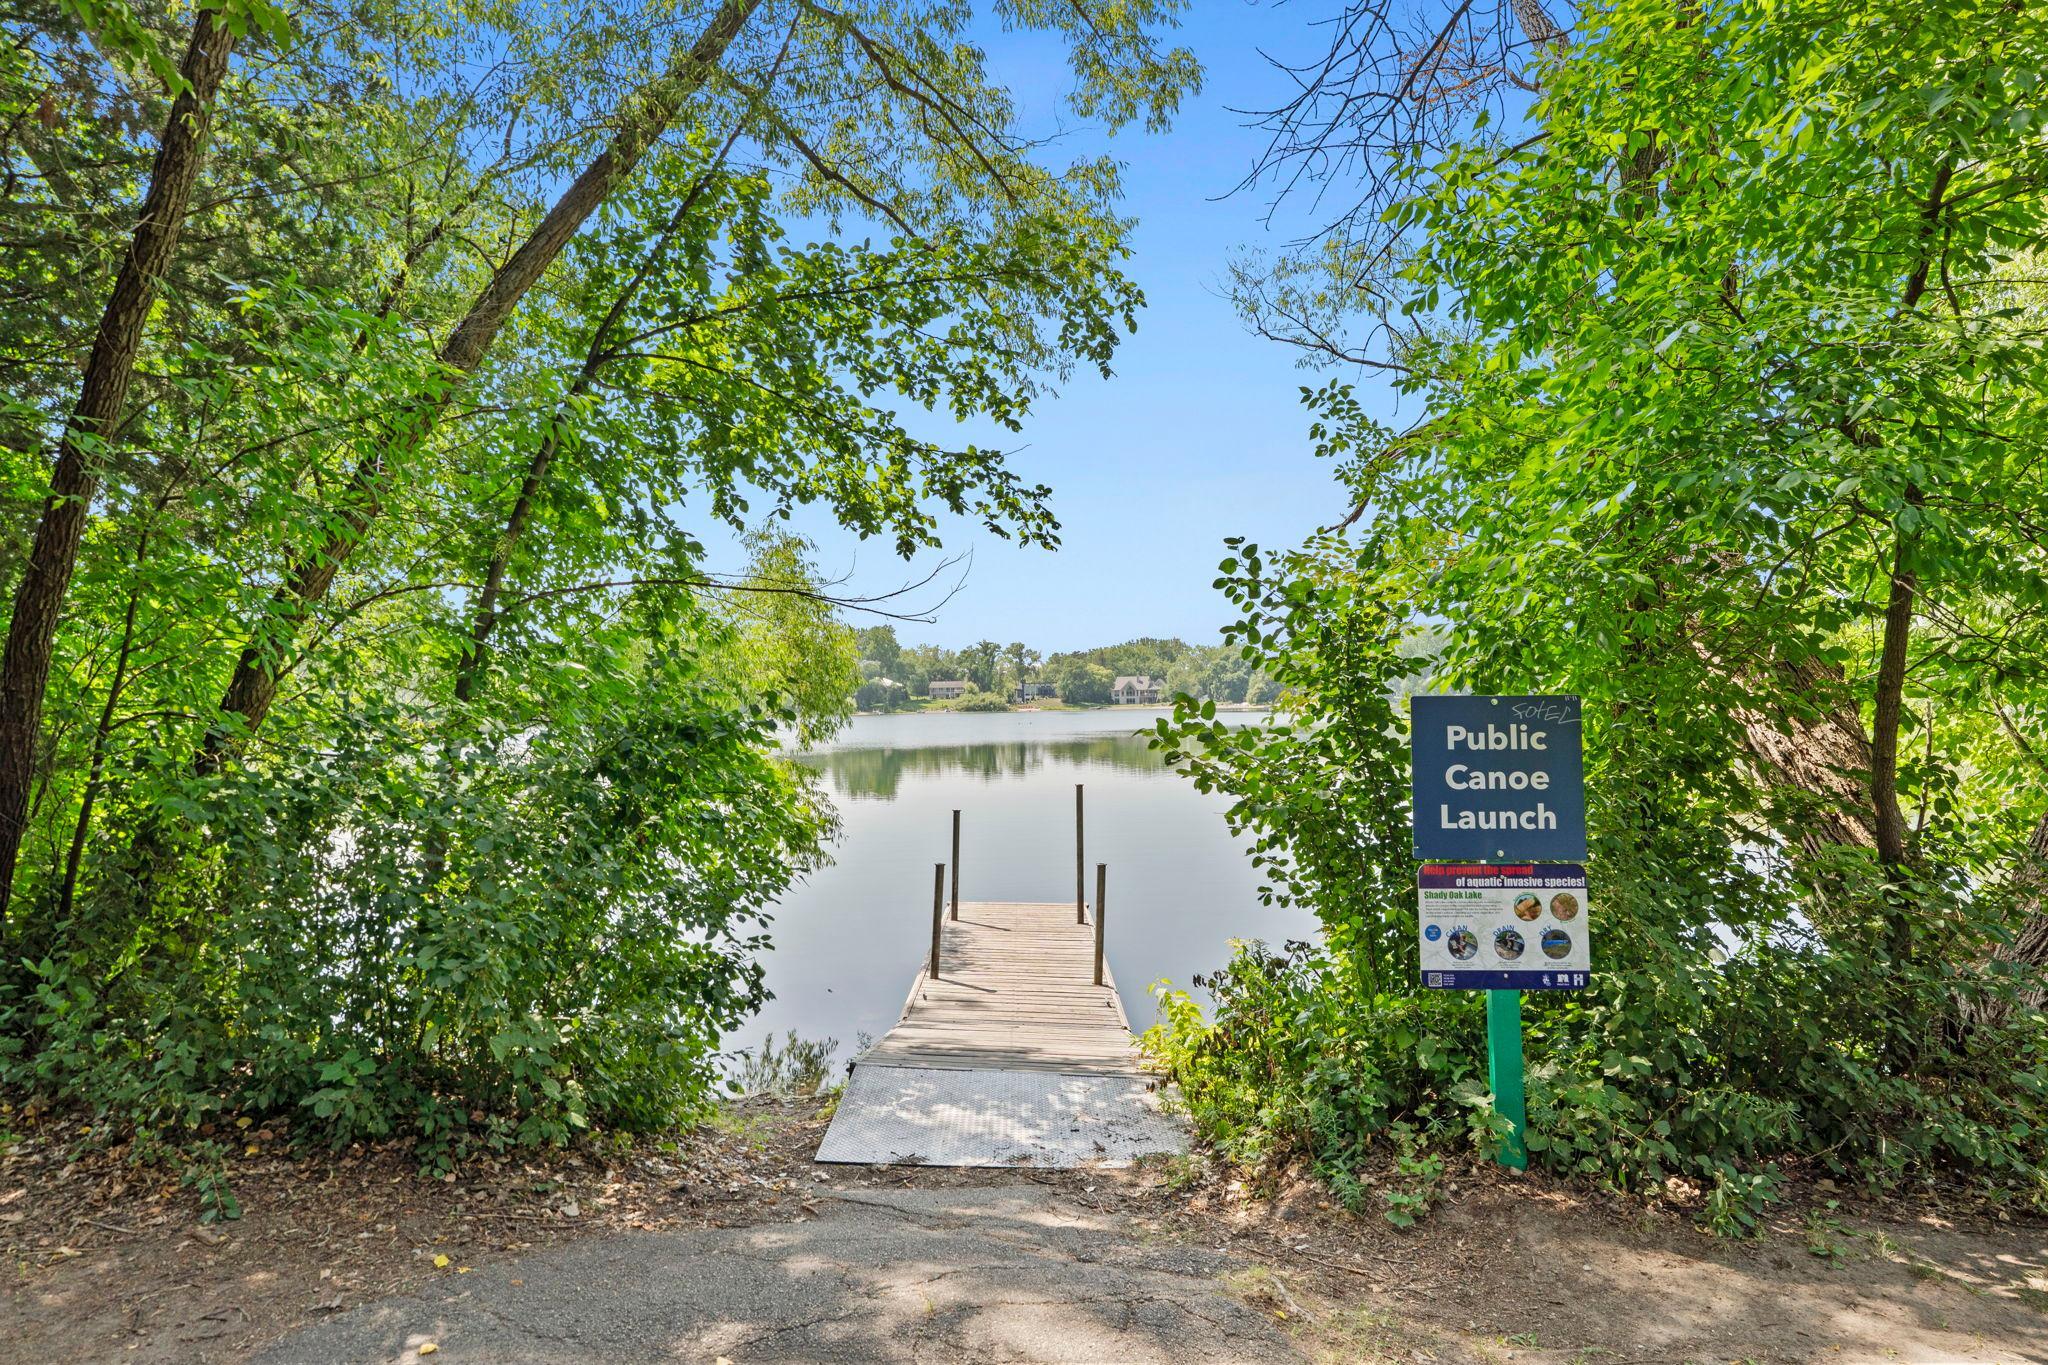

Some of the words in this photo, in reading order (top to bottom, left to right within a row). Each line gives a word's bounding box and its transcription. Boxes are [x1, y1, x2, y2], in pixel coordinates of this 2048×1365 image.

[1446, 723, 1548, 750] Public
[1444, 764, 1550, 790] Canoe
[1440, 803, 1557, 830] Launch
[1423, 865, 1445, 876] Help
[1446, 865, 1482, 876] prevent
[1483, 865, 1498, 875] the
[1500, 865, 1534, 876] spread
[1455, 876, 1466, 887] of
[1466, 876, 1502, 888] aquatic
[1503, 876, 1543, 887] invasive
[1544, 876, 1585, 888] species!
[1424, 890, 1448, 900] Shady
[1449, 890, 1464, 899] Oak
[1464, 890, 1483, 899] Lake
[1445, 924, 1469, 938] CLEAN
[1492, 924, 1516, 937] DRAIN
[1539, 923, 1553, 937] DRY
